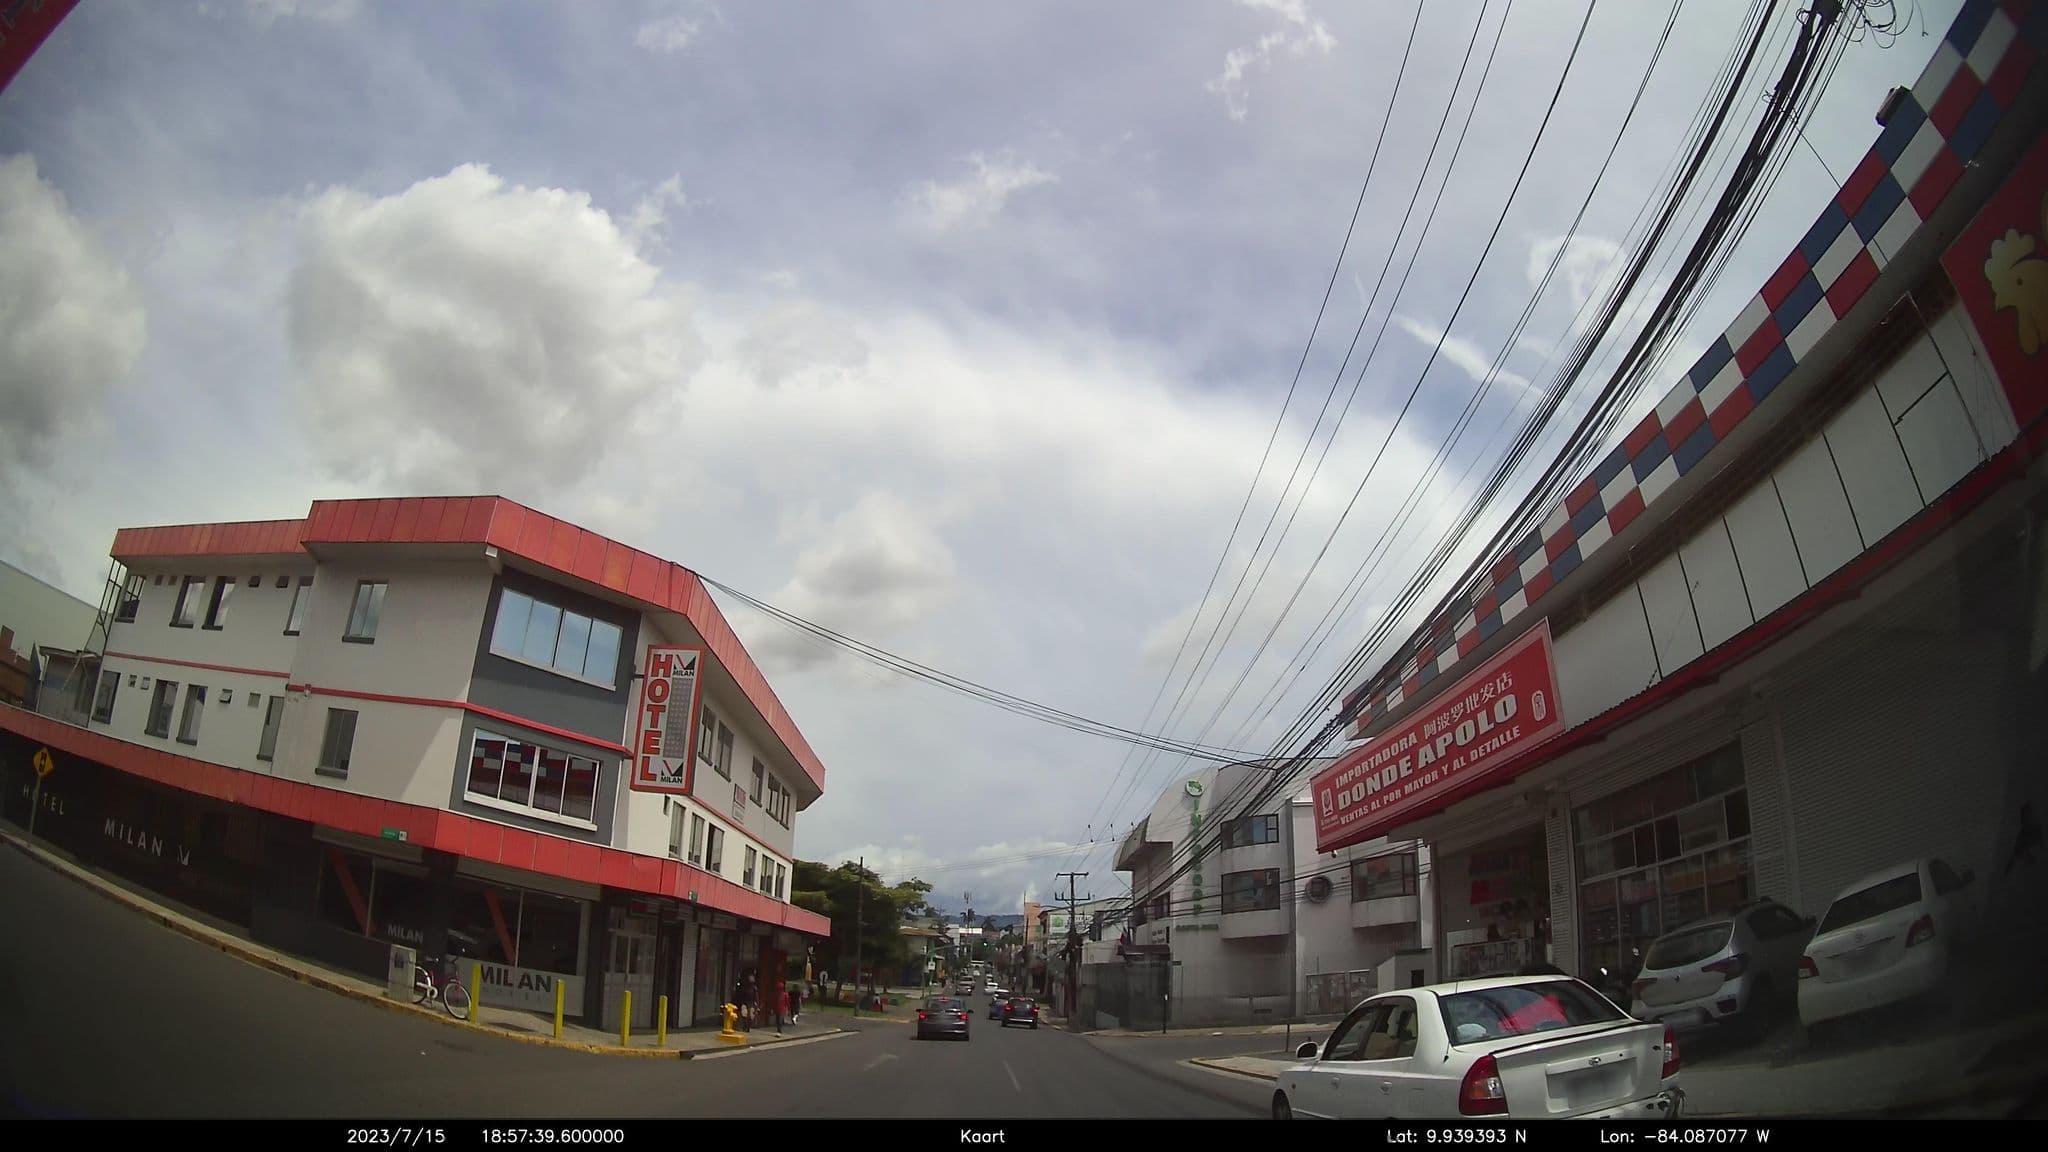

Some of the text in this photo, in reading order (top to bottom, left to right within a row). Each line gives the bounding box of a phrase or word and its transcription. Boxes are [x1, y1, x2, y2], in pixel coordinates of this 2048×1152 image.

[672, 669, 695, 677] MILAN
[640, 653, 674, 782] HOTEL
[1423, 671, 1513, 739] 阿波罗批发店
[1335, 732, 1418, 789] IMPORTADORA
[1338, 693, 1517, 810] DONDE APOLO
[1340, 805, 1369, 825] VENTAS
[1370, 799, 1381, 811] AL
[1383, 789, 1402, 805] POR
[1404, 770, 1439, 795] MAYOR
[1441, 763, 1449, 776] Y
[1452, 756, 1467, 771] AL
[1470, 725, 1521, 762] DETALLE
[660, 775, 683, 784] MILAN
[104, 817, 164, 857] MILAN
[387, 923, 424, 943] MILAN
[480, 963, 551, 993] MILAN
